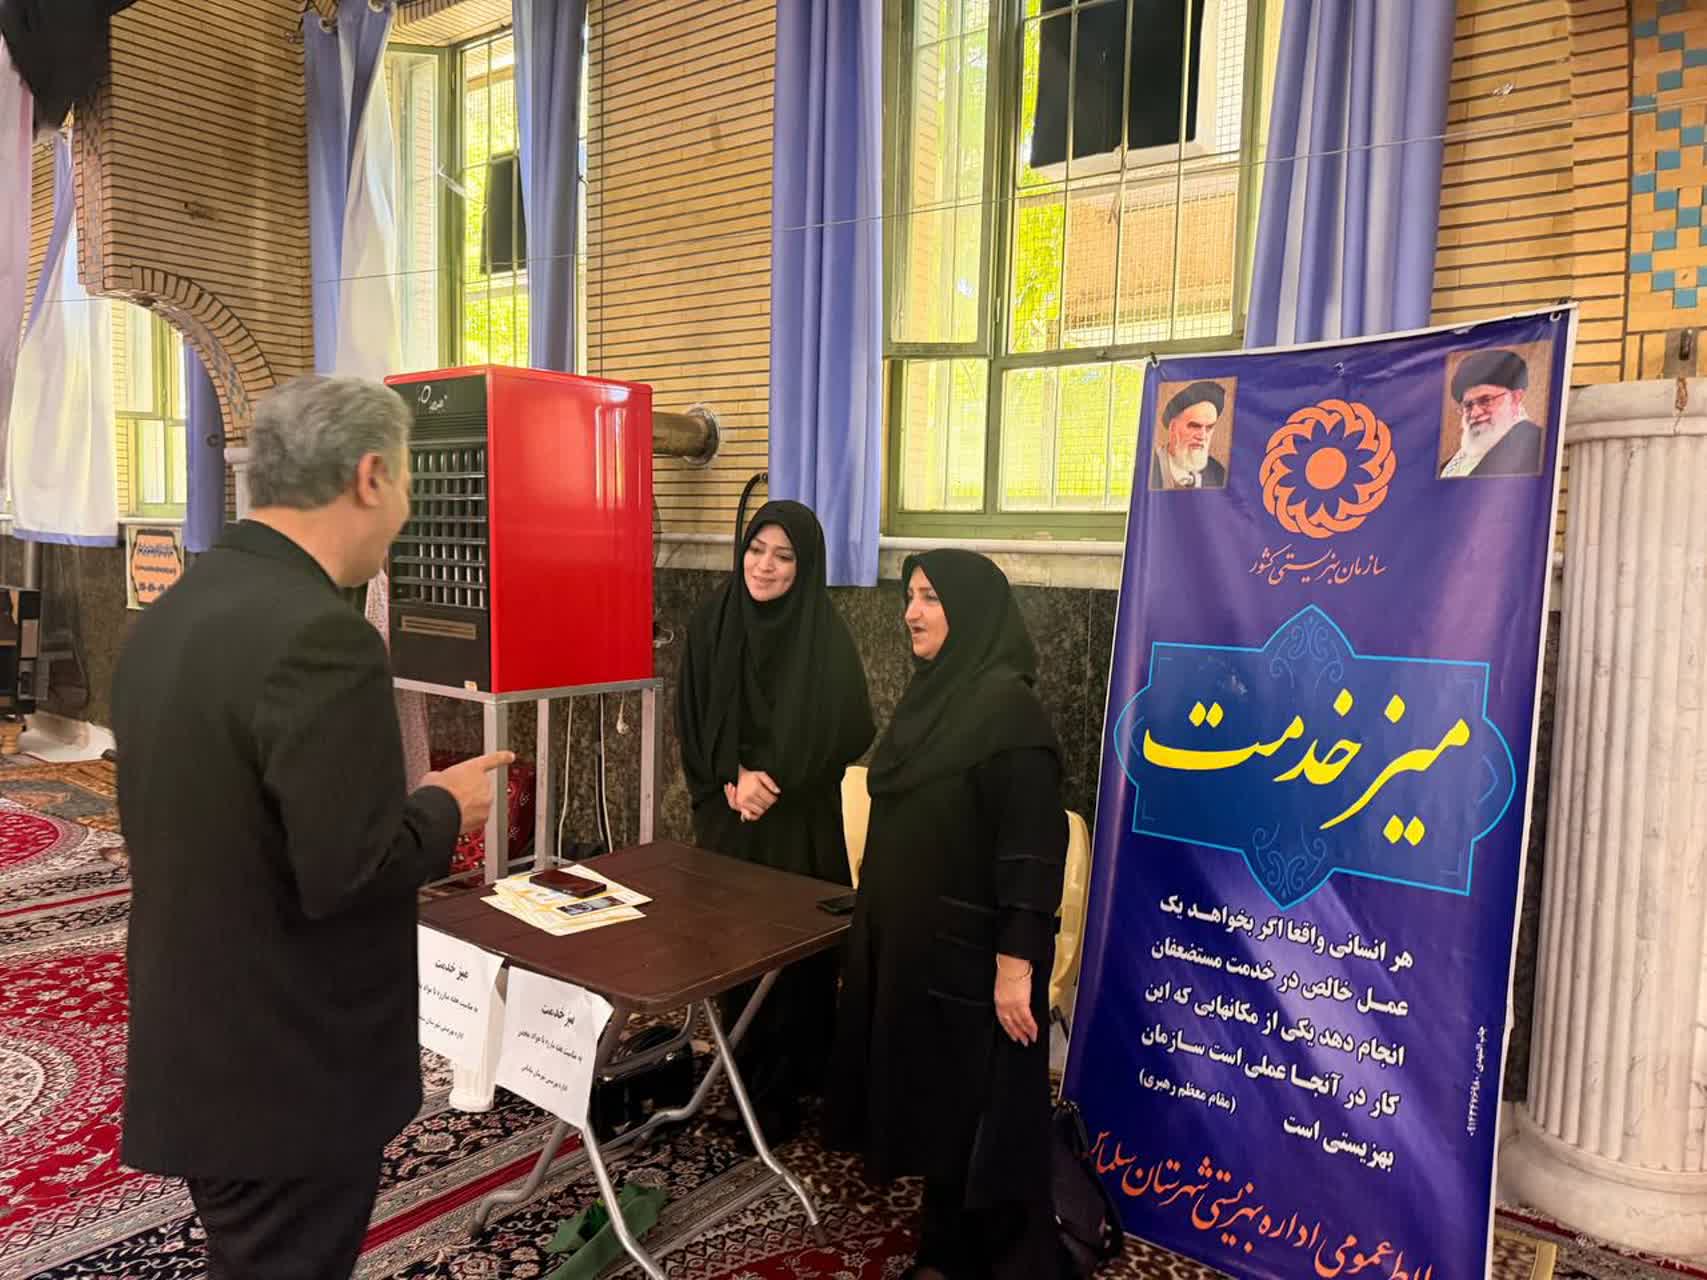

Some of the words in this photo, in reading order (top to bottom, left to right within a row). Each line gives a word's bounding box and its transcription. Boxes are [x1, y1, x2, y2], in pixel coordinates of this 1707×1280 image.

[1248, 543, 1292, 575] کشور
[1268, 548, 1340, 585] بهزیستی
[1334, 553, 1387, 584] سازمان
[1142, 688, 1362, 784] خدمت
[1319, 694, 1470, 846] میز
[1160, 895, 1183, 919] یک
[1187, 901, 1255, 936] بخواهد
[1257, 917, 1284, 941] اگر
[1287, 918, 1326, 955] واقعا
[1151, 937, 1223, 969] مستضعفان
[1329, 934, 1386, 961] انسانی
[1226, 956, 1275, 982] خدمت
[1389, 952, 1414, 972] هر
[1145, 981, 1171, 1004] این
[1173, 987, 1193, 1005] که
[1278, 971, 1300, 993] در
[1302, 976, 1353, 1001] خالص
[1194, 993, 1260, 1025] مکانهایی
[1356, 988, 1409, 1017] عمل
[1262, 1011, 1279, 1035] از
[1281, 1019, 1316, 1047] یکی
[1141, 1023, 1205, 1053] سازمان
[1319, 1029, 1355, 1052] دهد
[1208, 1043, 1243, 1067] است
[1357, 1038, 1405, 1068] انجام
[1244, 1055, 1287, 1080] عملی
[1291, 1065, 1342, 1098] آنجا
[1177, 1081, 1207, 1102] معظم
[1344, 1088, 1367, 1109] در
[1368, 1092, 1401, 1118] کار
[1283, 1114, 1320, 1141] است
[1322, 1132, 1394, 1172] بهزیستی
[1121, 1156, 1211, 1207] شهرستان
[1191, 1169, 1264, 1253] بهزیستی
[1258, 1211, 1320, 1249] اداره
[1314, 1234, 1394, 1279] عمومی
